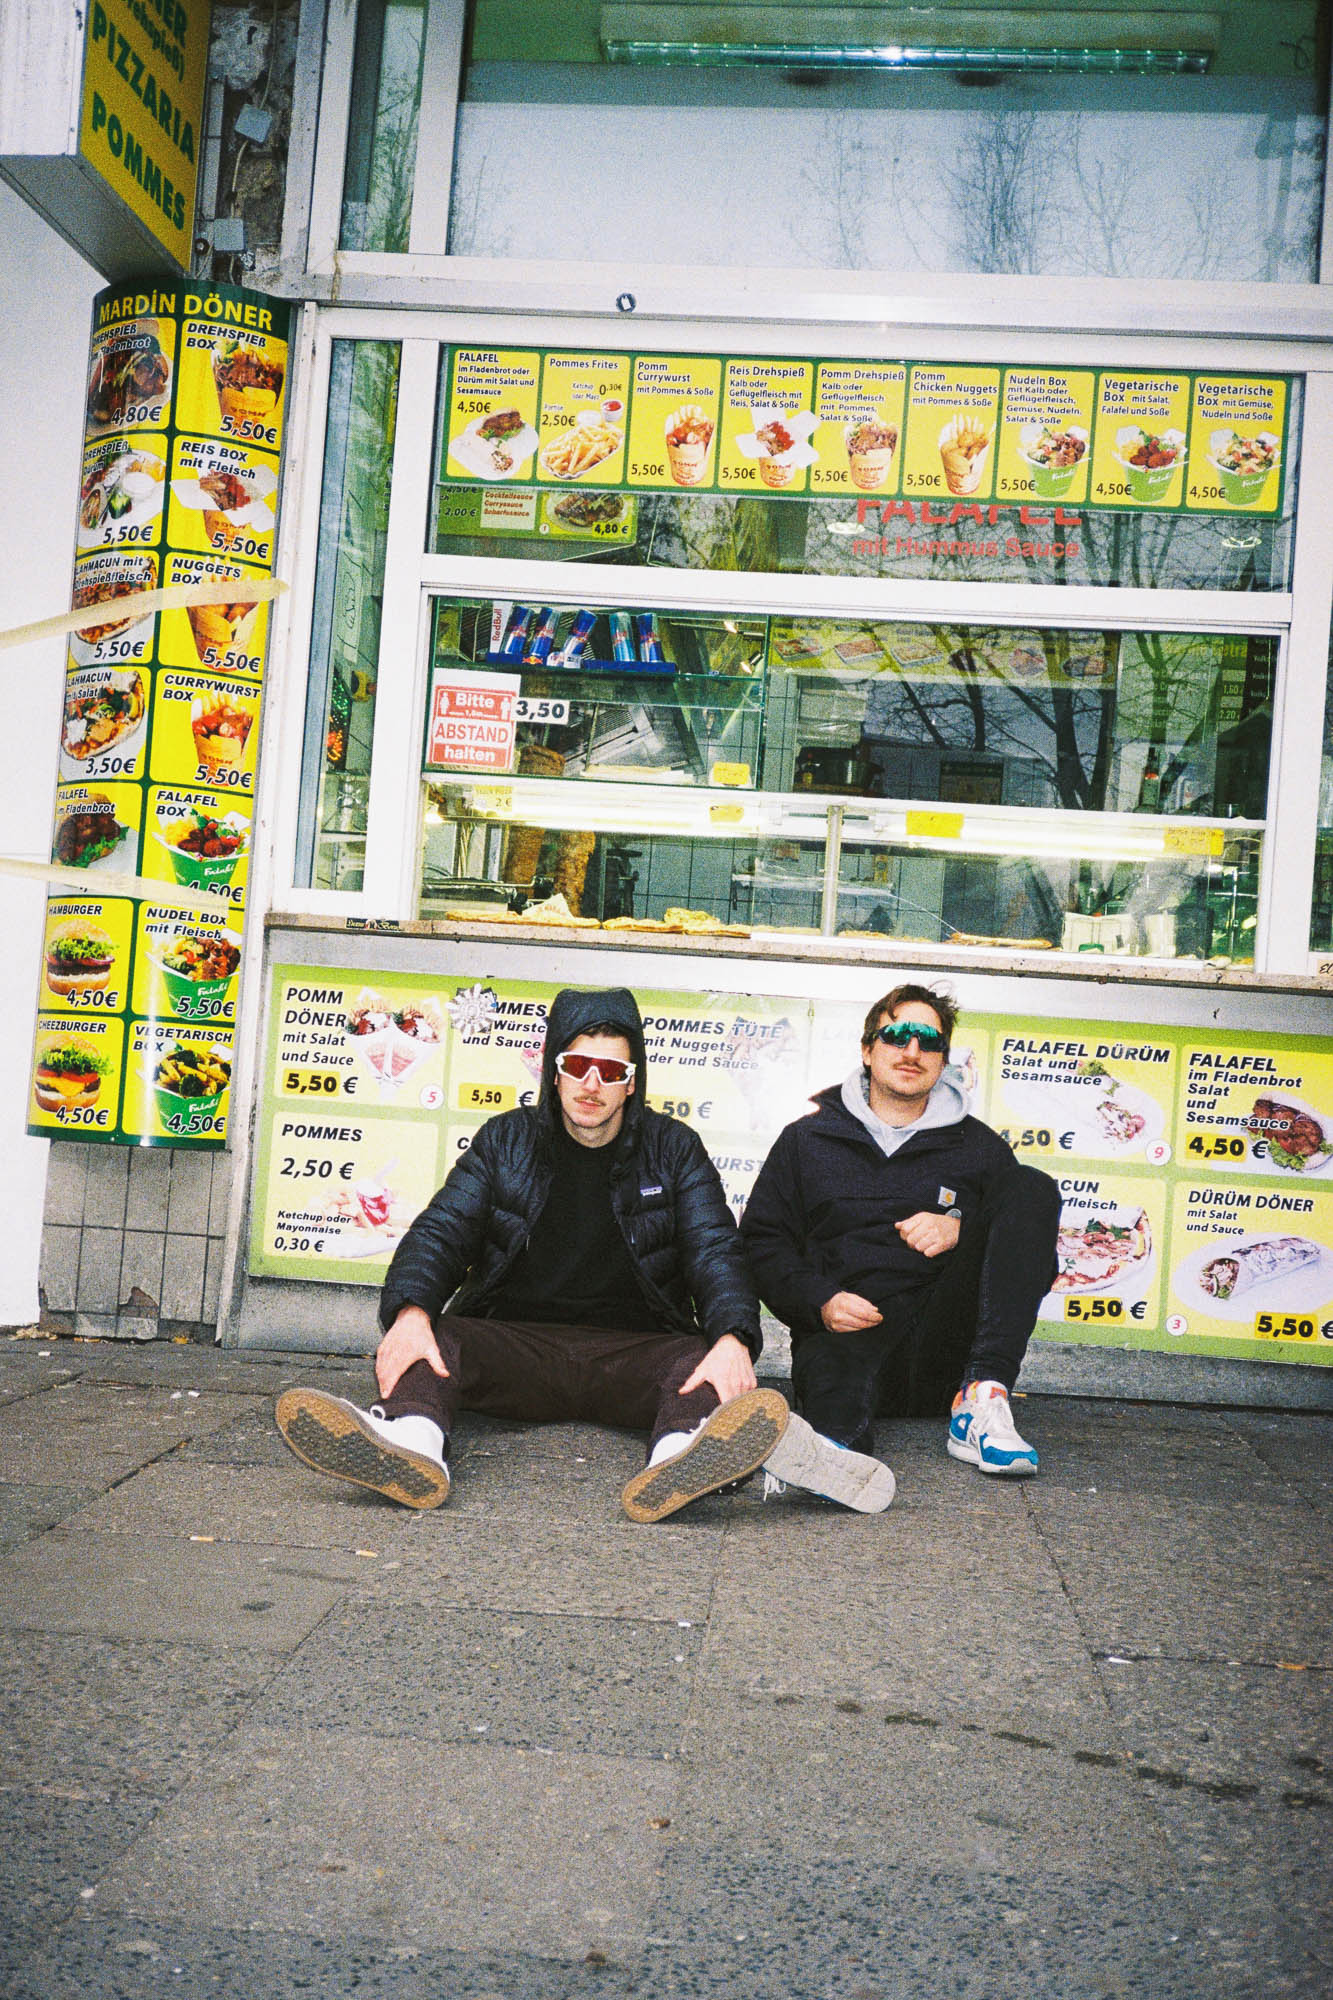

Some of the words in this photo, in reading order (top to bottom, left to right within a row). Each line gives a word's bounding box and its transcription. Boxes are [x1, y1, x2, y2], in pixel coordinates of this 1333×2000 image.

[92, 2, 194, 165] PIZZARIA
[92, 91, 186, 231] POMMES
[184, 293, 272, 331] DÖNER
[186, 337, 217, 350] BOX
[459, 353, 499, 363] FALAFEL
[550, 358, 589, 369] Pommes
[592, 360, 619, 369] Frites
[469, 366, 510, 375] Fladenbrot
[513, 367, 530, 375] oder
[638, 361, 668, 371] Pomm
[729, 366, 750, 376] Reis
[752, 366, 805, 379] Drehspieß
[457, 376, 483, 384] Dürüm
[500, 377, 518, 385] Salat
[520, 378, 535, 386] und
[637, 372, 691, 383] Currywurst
[821, 369, 851, 378] Pomm
[854, 370, 904, 381] Drehspieß
[914, 371, 946, 381] Pomm
[1009, 375, 1045, 385] Nudeln
[1048, 377, 1067, 386] Box
[730, 379, 747, 387] Kalb
[749, 380, 767, 388] oder
[822, 383, 841, 391] Kalb
[843, 383, 863, 391] oder
[913, 382, 953, 392] Chicken
[955, 384, 997, 396] Nuggets
[1104, 379, 1179, 393] Vegetarische
[1198, 383, 1274, 397] Vegetarische
[456, 387, 502, 396] Sesamsauce
[651, 387, 685, 395] Pommes
[729, 388, 787, 399] Geflügelfleisch
[1104, 392, 1124, 402] Box
[1132, 394, 1146, 403] mit
[457, 401, 491, 413] 4,50€
[750, 399, 770, 408] Salat
[1197, 396, 1219, 406] Box
[1222, 398, 1237, 407] mit
[112, 406, 162, 425] 4,80€
[1102, 406, 1129, 414] Falafel
[1131, 407, 1147, 415] und
[1202, 410, 1232, 418] Nudeln
[542, 414, 576, 427] 2,50€
[220, 416, 278, 444] 5,50€
[181, 441, 215, 456] REIS
[218, 446, 248, 463] BOX
[179, 456, 203, 469] mit
[208, 460, 256, 479] Fleisch
[631, 464, 665, 477] 5,50€
[722, 468, 756, 480] 5,50€
[814, 470, 848, 482] 5,50€
[907, 474, 941, 487] 5,50€
[1001, 479, 1036, 492] 5,50€
[1096, 483, 1132, 495] 4,50€
[1189, 486, 1226, 499] 4,50€
[103, 525, 153, 544] 5,50€
[211, 533, 269, 560] 5,50€
[852, 535, 888, 556] mit
[896, 535, 998, 556] Hummus
[1005, 537, 1079, 557] Sauce
[123, 556, 144, 567] mit
[172, 558, 241, 578] NUGGETS
[171, 573, 202, 585] BOX
[95, 640, 145, 658] 5,50€
[203, 647, 261, 672] 5,50€
[164, 674, 261, 699] CURRYWURST
[163, 689, 194, 701] BOX
[455, 692, 495, 708] Bitte
[516, 700, 565, 720] 3,50
[434, 722, 508, 743] ABSTAND
[444, 746, 496, 763] halten
[86, 757, 136, 776] 3,50€
[195, 764, 253, 788] 5,50€
[58, 788, 89, 800] FALAFEL
[157, 790, 219, 807] FALAFEL
[66, 802, 115, 814] Fladenbrot
[156, 805, 187, 817] BOX
[49, 905, 102, 916] HAMBURGER
[147, 908, 195, 921] NUDEL
[200, 911, 227, 925] BOX
[145, 923, 168, 934] mit
[173, 925, 222, 939] Fleisch
[67, 989, 118, 1008] 4,50€
[286, 988, 343, 1005] POMM
[177, 997, 235, 1017] 5,50€
[284, 1008, 347, 1028] DÖNER
[38, 1020, 107, 1033] CHEEZBURGER
[643, 1017, 725, 1035] POMMES
[732, 1020, 783, 1038] TÜTE
[282, 1032, 306, 1044] mit
[310, 1033, 346, 1047] Salat
[463, 1036, 490, 1045] und
[495, 1036, 541, 1049] Sauce
[1003, 1038, 1089, 1057] FALAFEL
[1096, 1044, 1170, 1063] DÜRÜM
[282, 1051, 309, 1063] und
[312, 1052, 354, 1066] Sauce
[679, 1056, 706, 1067] und
[712, 1057, 759, 1070] Sauce
[1002, 1055, 1043, 1067] Salat
[1048, 1058, 1078, 1070] und
[1189, 1053, 1277, 1072] FALAFEL
[286, 1073, 337, 1093] 5,50
[343, 1076, 358, 1094] €
[1001, 1069, 1102, 1086] Sesamsauce
[1188, 1069, 1208, 1081] im
[1213, 1071, 1302, 1088] Fladenbrot
[427, 1091, 436, 1103] 5
[1188, 1083, 1230, 1097] Salat
[471, 1089, 502, 1104] 5,50
[519, 1091, 534, 1107] €
[1187, 1099, 1217, 1110] und
[56, 1107, 109, 1125] 4,50€
[697, 1101, 713, 1119] €
[168, 1114, 226, 1133] 4,50€
[1186, 1111, 1289, 1130] Sesamsauce
[282, 1123, 362, 1142] POMMES
[1058, 1131, 1075, 1149] €
[1154, 1147, 1164, 1159] 9
[1189, 1137, 1244, 1157] 4,50
[1252, 1140, 1269, 1159] €
[280, 1157, 333, 1179] 2,50
[339, 1161, 354, 1180] €
[1188, 1189, 1251, 1207] DÜRÜM
[1256, 1194, 1314, 1212] DÖNER
[277, 1210, 323, 1223] Ketchup
[326, 1213, 351, 1224] oder
[1187, 1209, 1206, 1218] mit
[1209, 1210, 1238, 1220] Salat
[276, 1223, 341, 1236] Mayonnaise
[1187, 1223, 1208, 1232] und
[1211, 1224, 1244, 1236] Sauce
[274, 1237, 309, 1253] 0,30
[314, 1239, 324, 1253] €
[1067, 1300, 1122, 1320] 5,50
[1130, 1301, 1147, 1319] €
[1172, 1319, 1181, 1330] 3
[1257, 1315, 1314, 1337] 5,50
